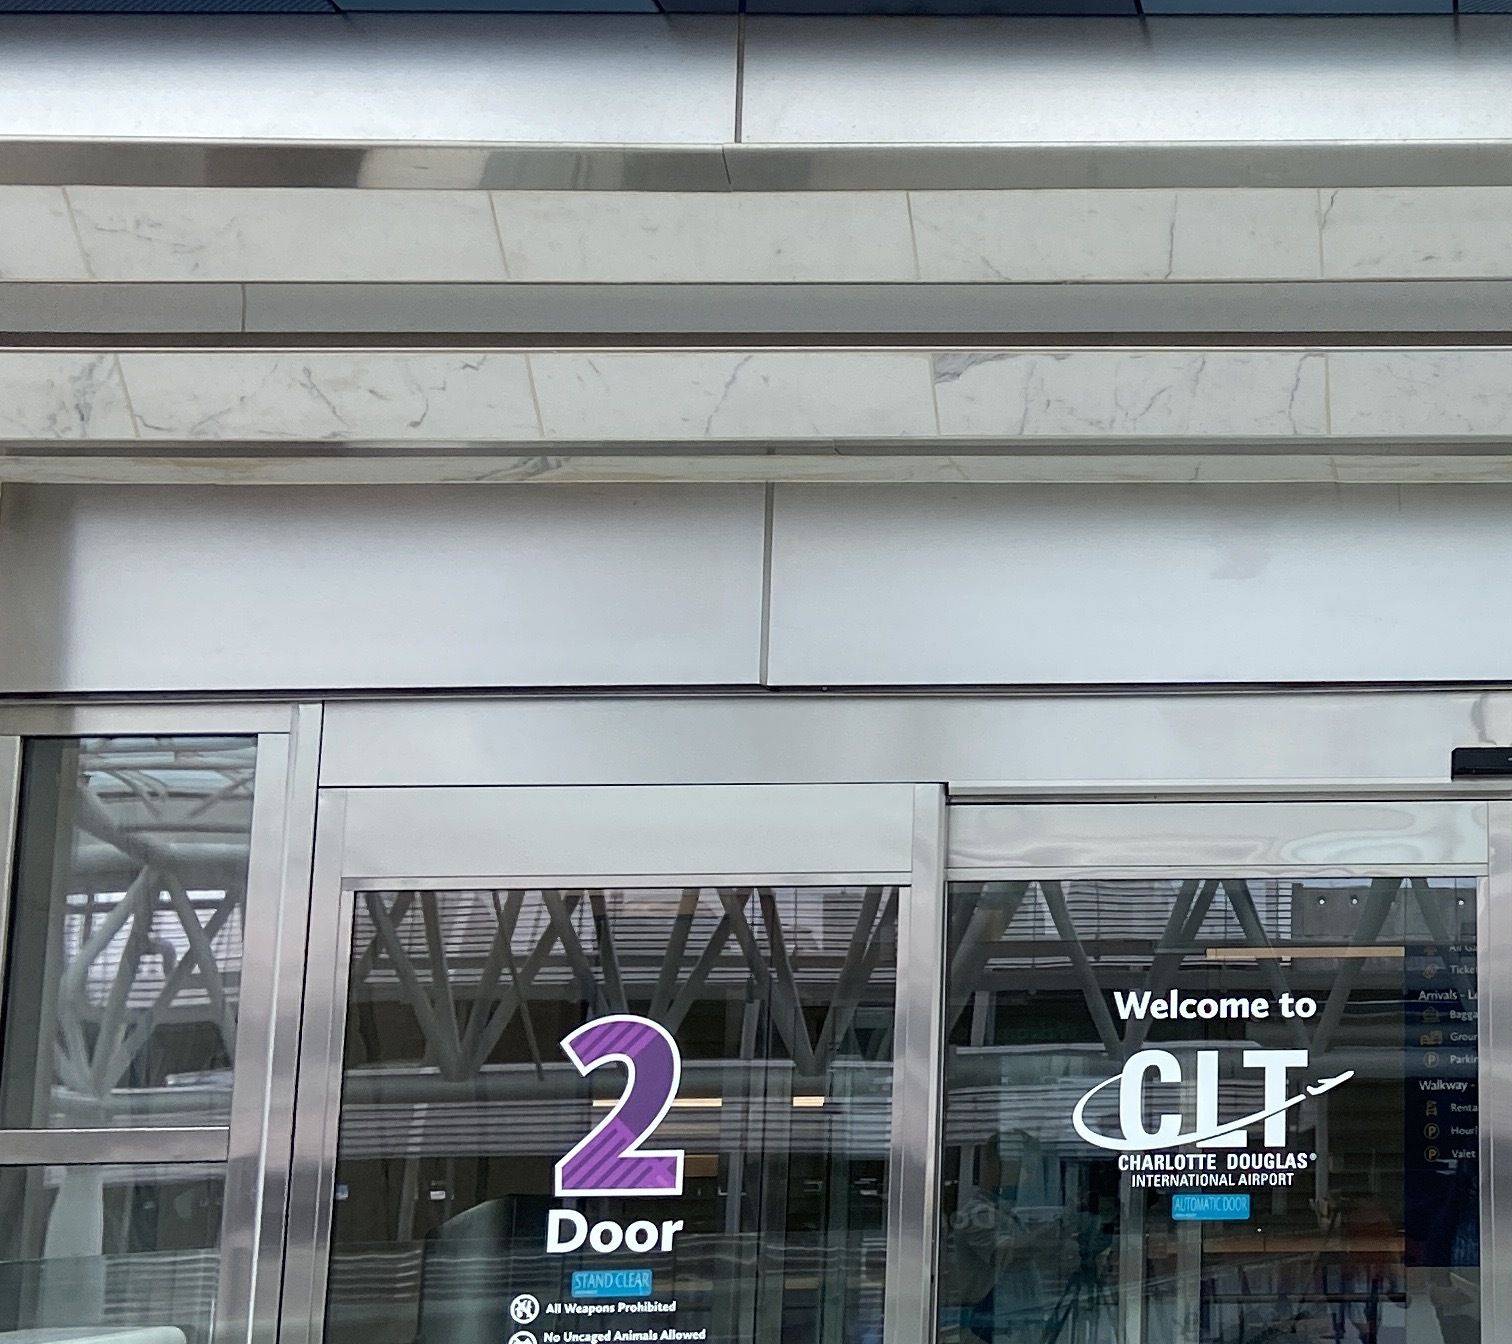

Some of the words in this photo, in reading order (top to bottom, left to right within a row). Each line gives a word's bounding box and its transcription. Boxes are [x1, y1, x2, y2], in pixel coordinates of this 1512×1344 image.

[1449, 964, 1478, 974] Ticke
[1418, 988, 1458, 1001] Arrivals
[1113, 989, 1270, 1020] Welcome
[1278, 992, 1317, 1018] to
[1419, 1079, 1468, 1093] Walkway
[555, 1014, 685, 1197] 2
[1119, 1049, 1309, 1149] CLT
[1451, 1148, 1476, 1159] Valet
[1118, 1153, 1217, 1171] CHARLOTTE
[1131, 1173, 1236, 1188] INTERNATIONAL
[1237, 1172, 1295, 1187] AIRPORT
[1174, 1197, 1222, 1212] AUTOMATIC
[1222, 1196, 1248, 1212] DOOR
[546, 1209, 684, 1253] Door
[574, 1272, 613, 1289] STAND
[615, 1272, 650, 1288] CLEAR
[546, 1302, 562, 1314] All
[564, 1302, 615, 1316] Weapons
[618, 1300, 677, 1313] Prohibited
[543, 1331, 561, 1343] No
[563, 1330, 611, 1344] Uncaged
[614, 1329, 658, 1342] Animals
[660, 1328, 707, 1341] Allowed
